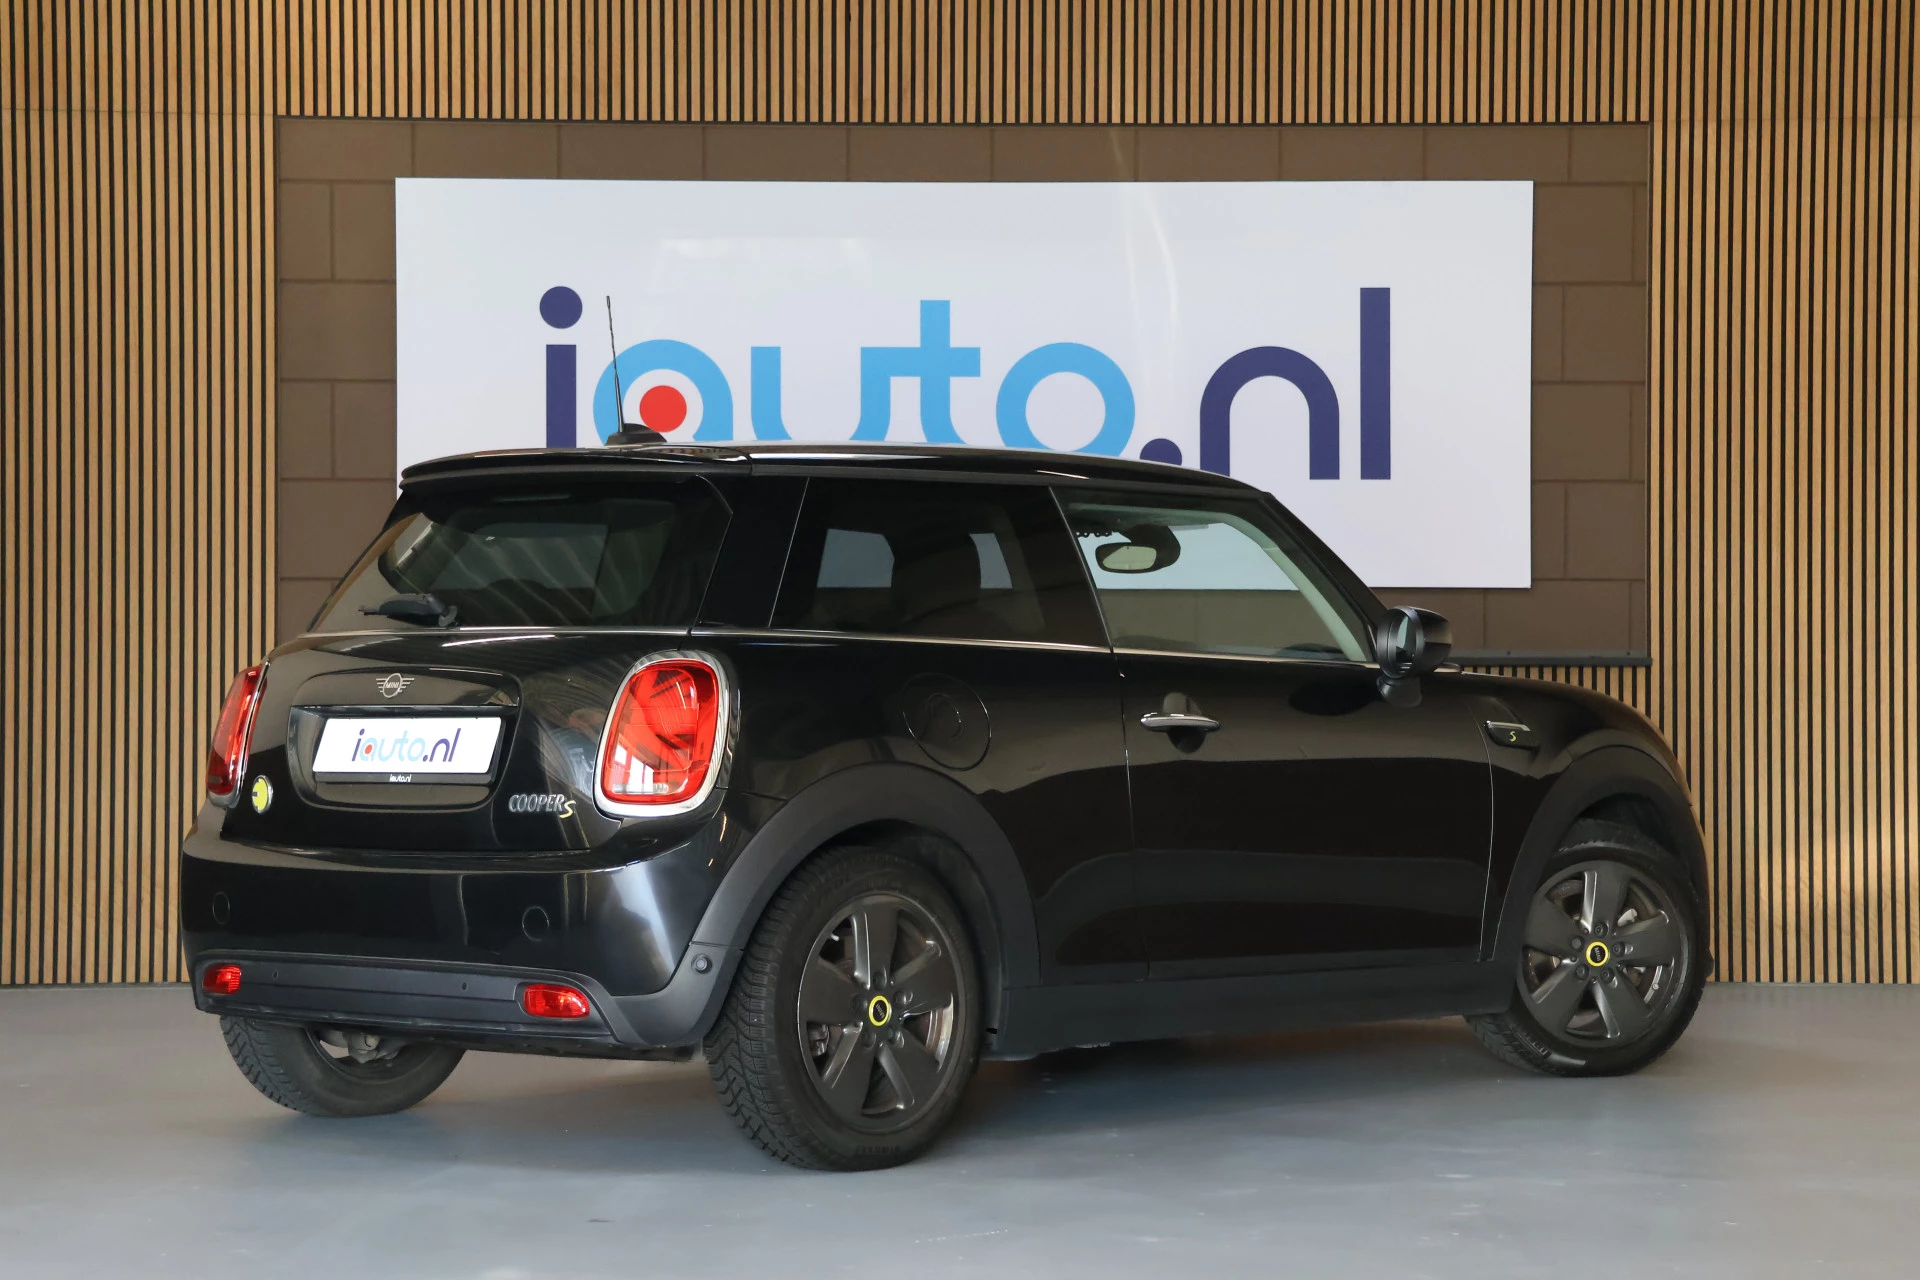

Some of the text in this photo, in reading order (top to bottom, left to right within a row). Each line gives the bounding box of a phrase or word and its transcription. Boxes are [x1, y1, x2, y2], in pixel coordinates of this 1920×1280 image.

[539, 286, 1391, 480] iauto.nl
[385, 681, 400, 689] MINI
[351, 727, 462, 762] iauto.nl
[1509, 731, 1517, 742] S
[508, 793, 576, 818] COOPER S
